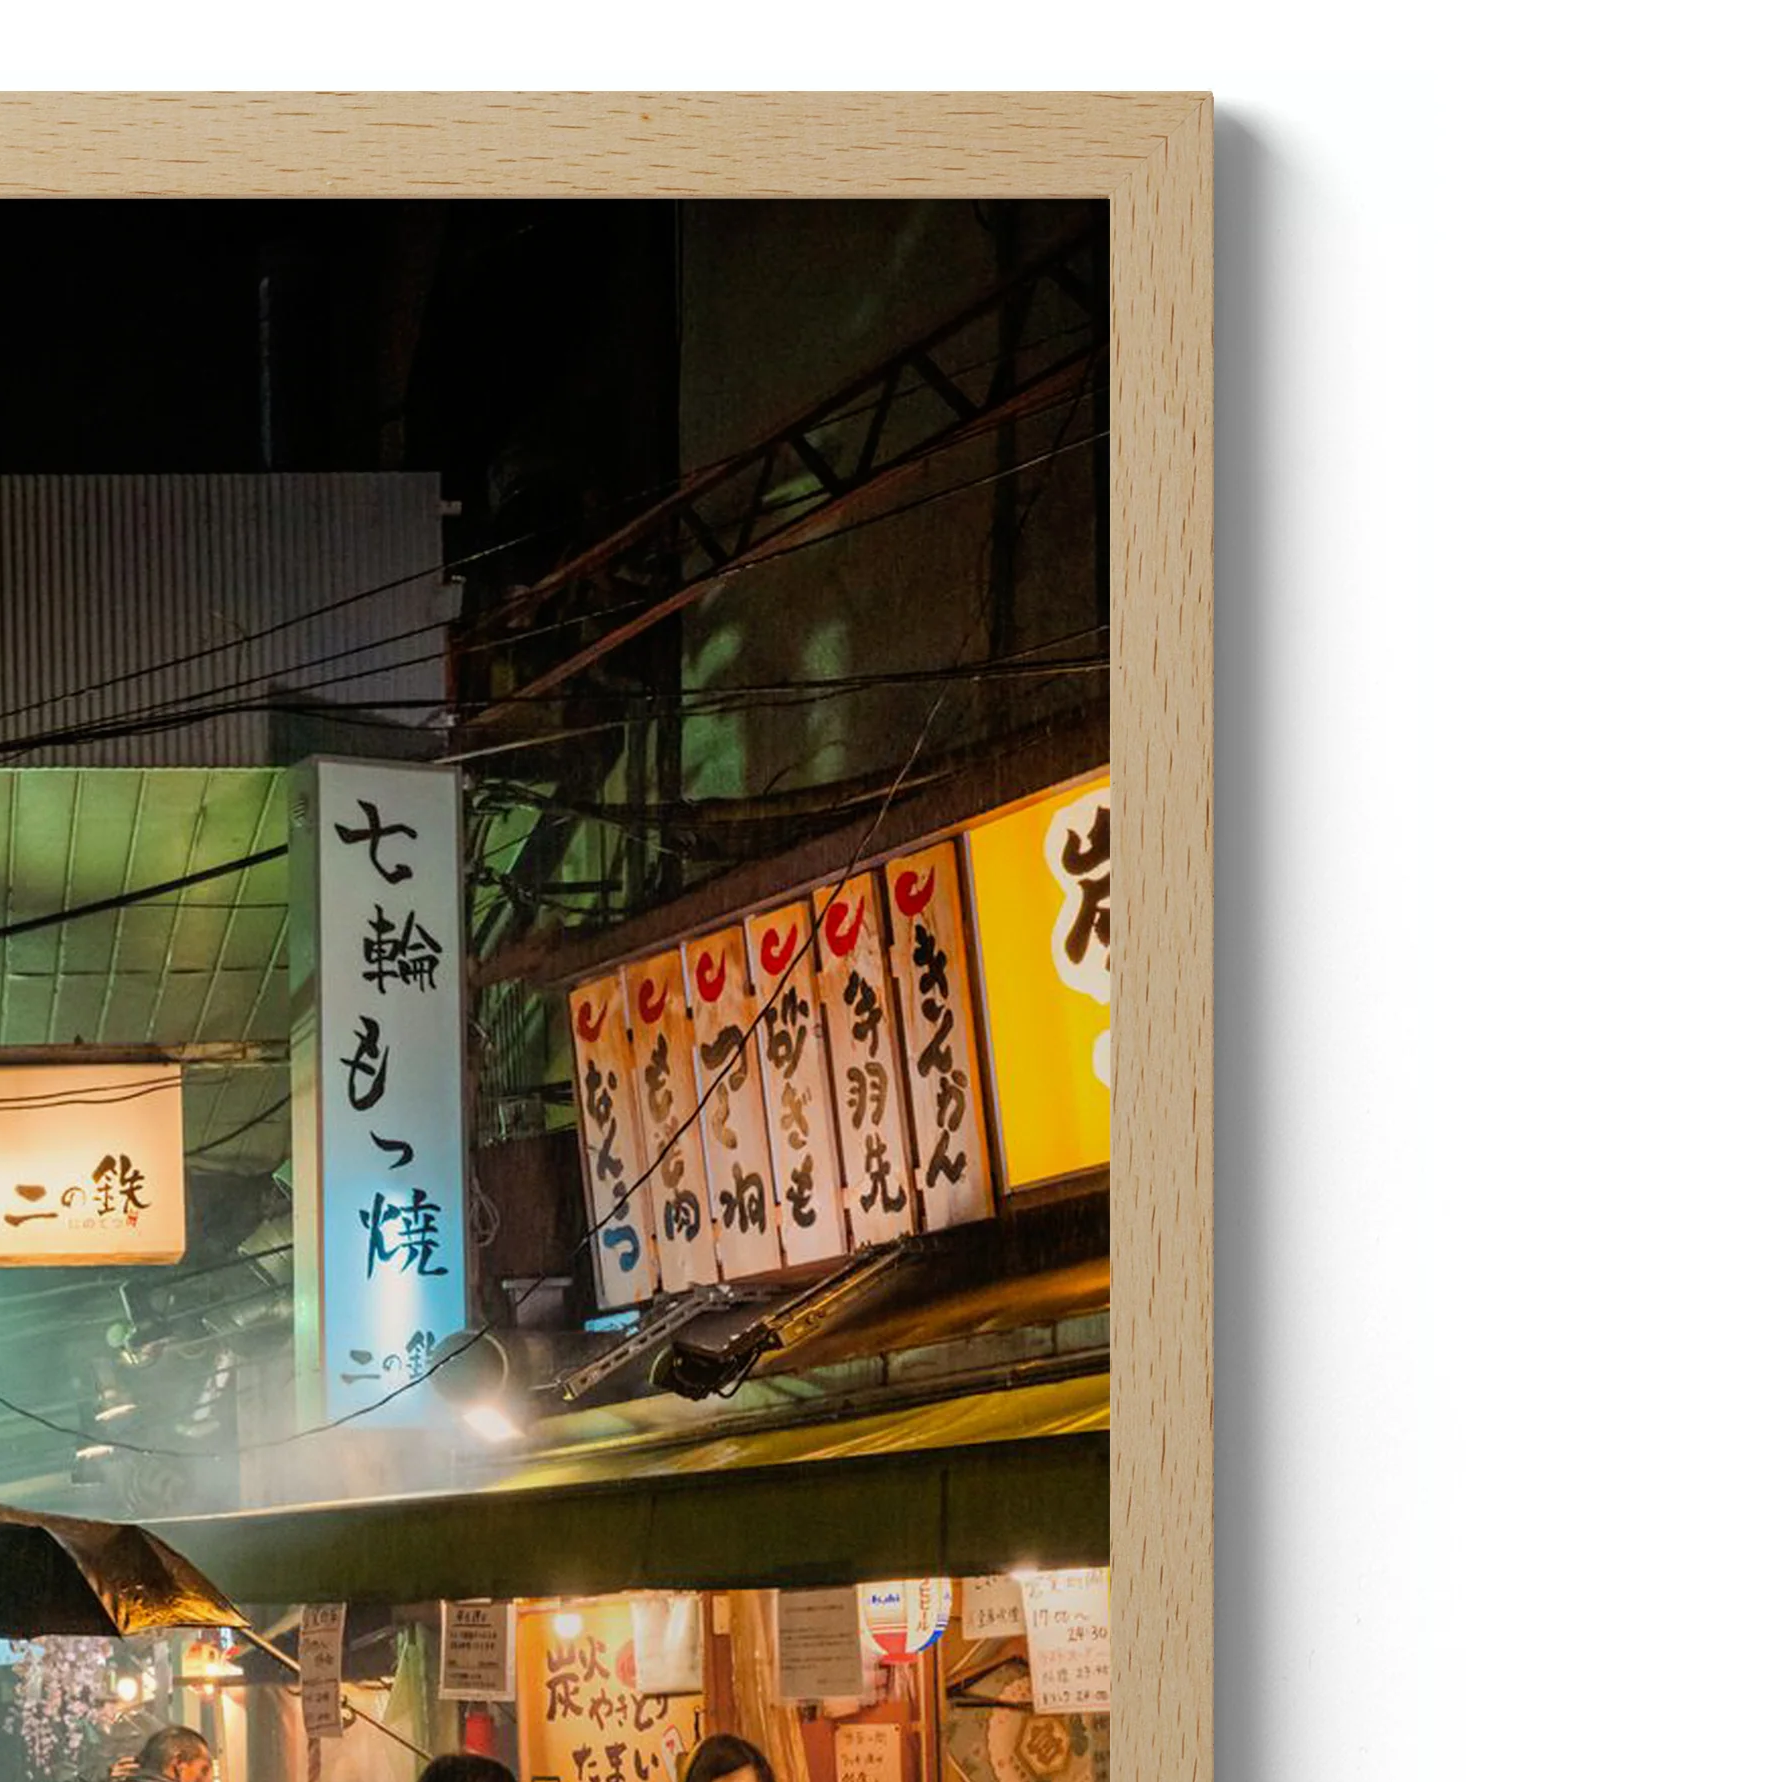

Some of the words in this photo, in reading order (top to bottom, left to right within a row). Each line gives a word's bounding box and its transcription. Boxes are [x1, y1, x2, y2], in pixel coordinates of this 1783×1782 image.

[335, 800, 447, 1280] 七輪もつ焼
[843, 969, 908, 1213] 手羽先
